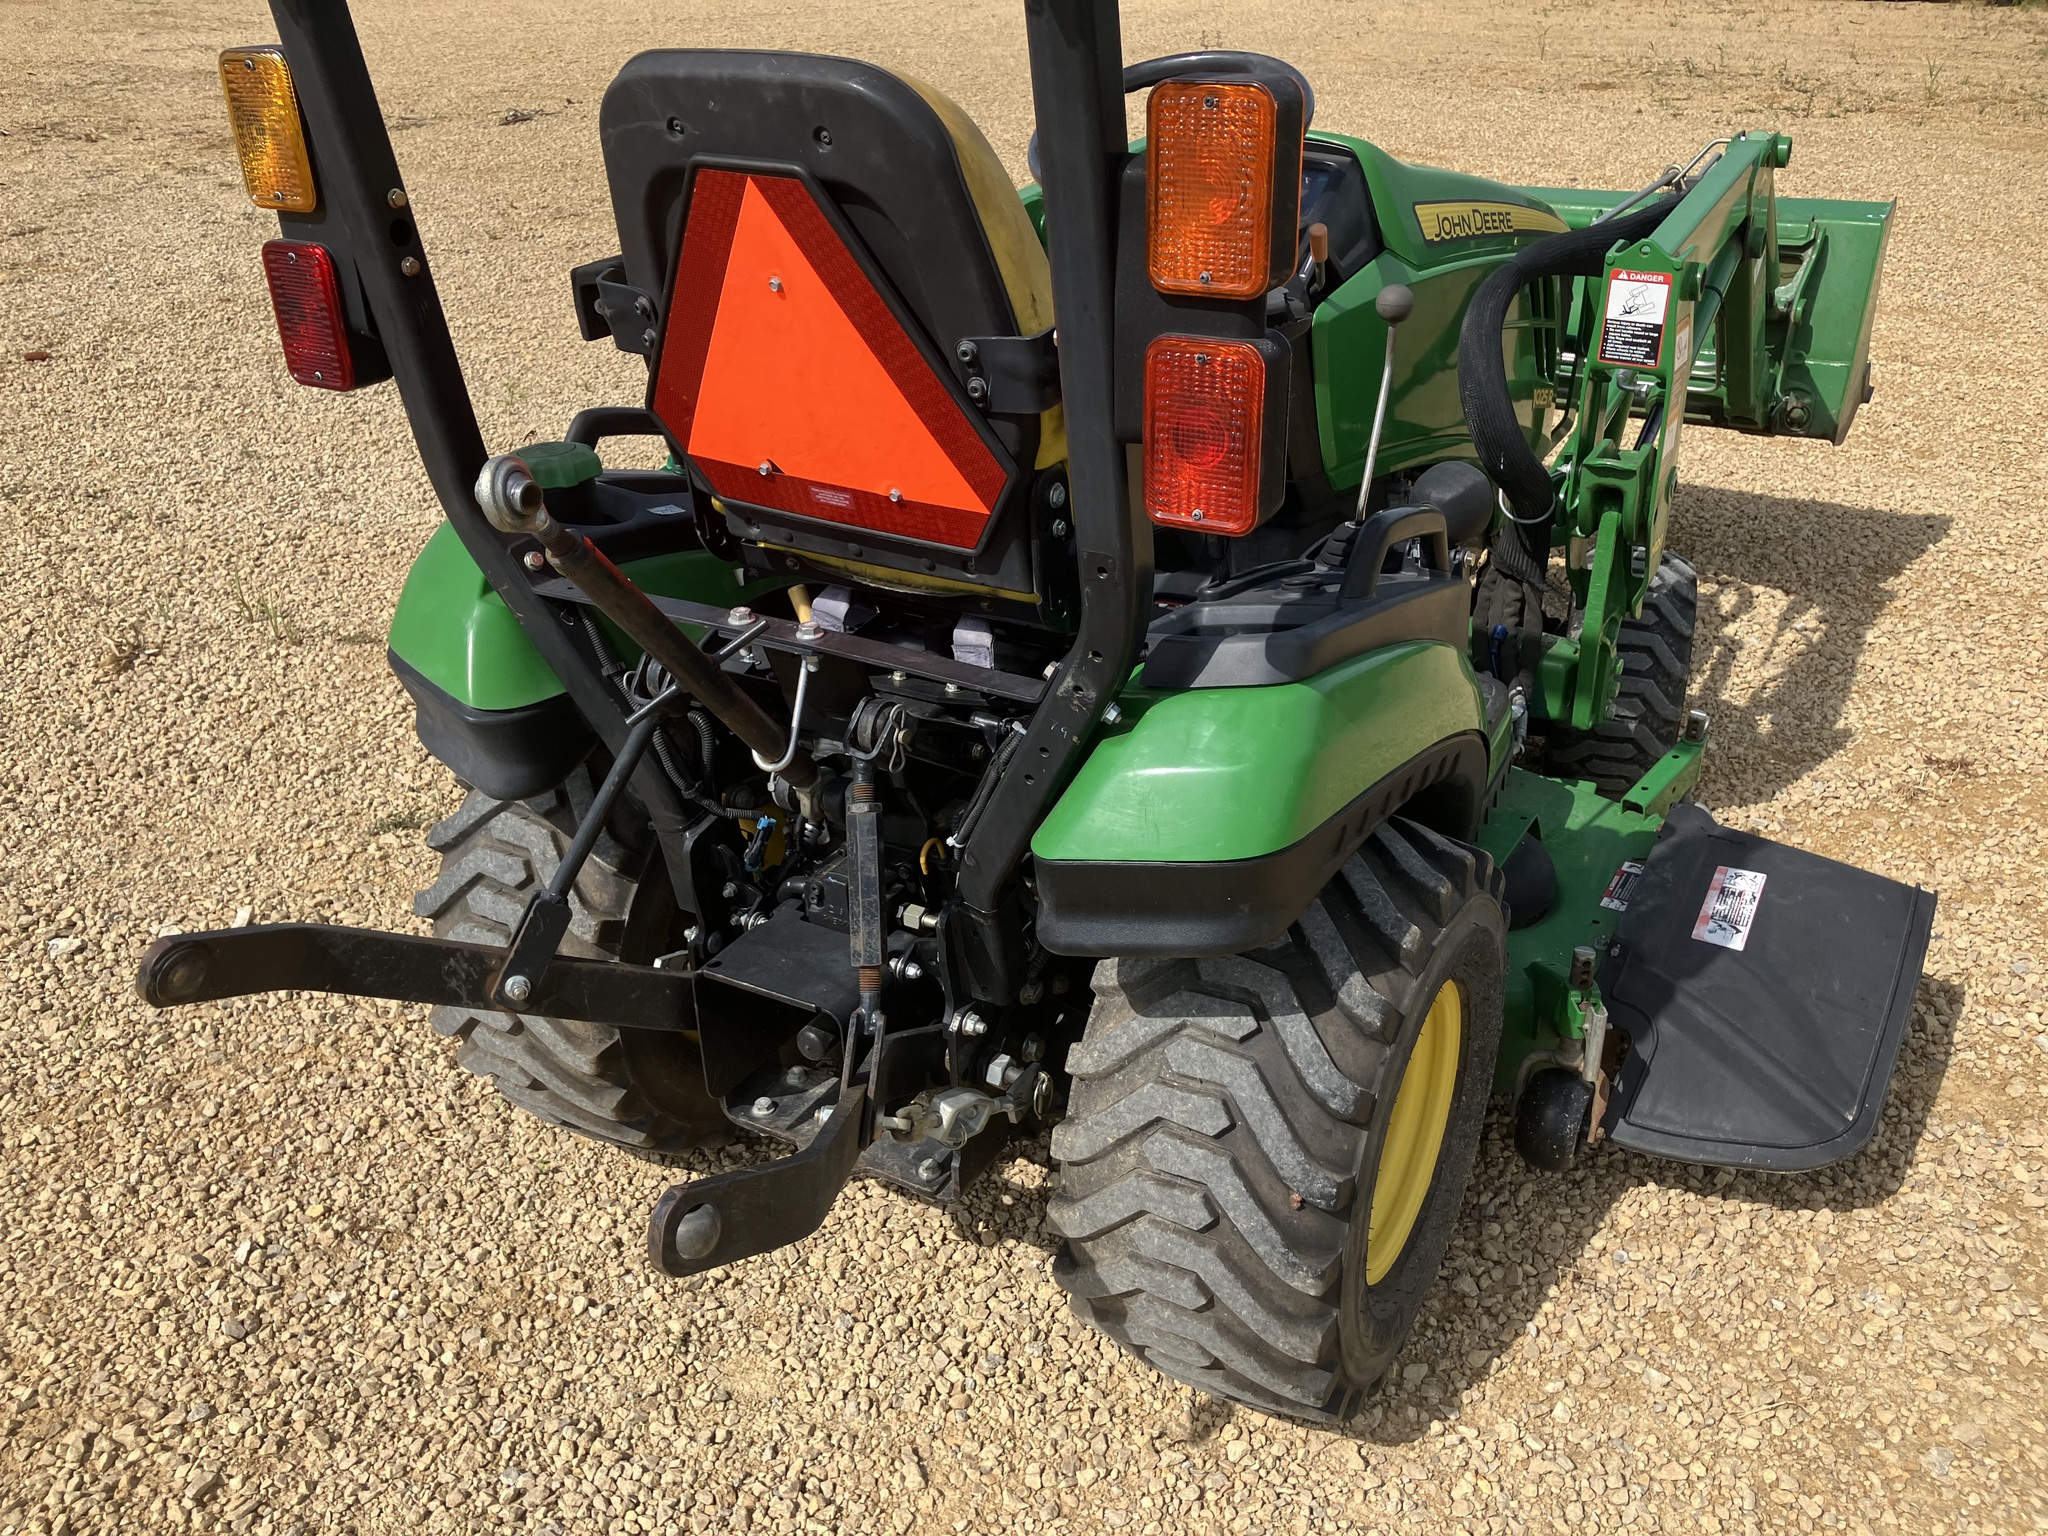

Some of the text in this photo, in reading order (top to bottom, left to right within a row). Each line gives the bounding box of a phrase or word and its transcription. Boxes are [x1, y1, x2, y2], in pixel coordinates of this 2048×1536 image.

[1434, 209, 1514, 238] JOHN DEERE
[1630, 273, 1664, 282] DANGER
